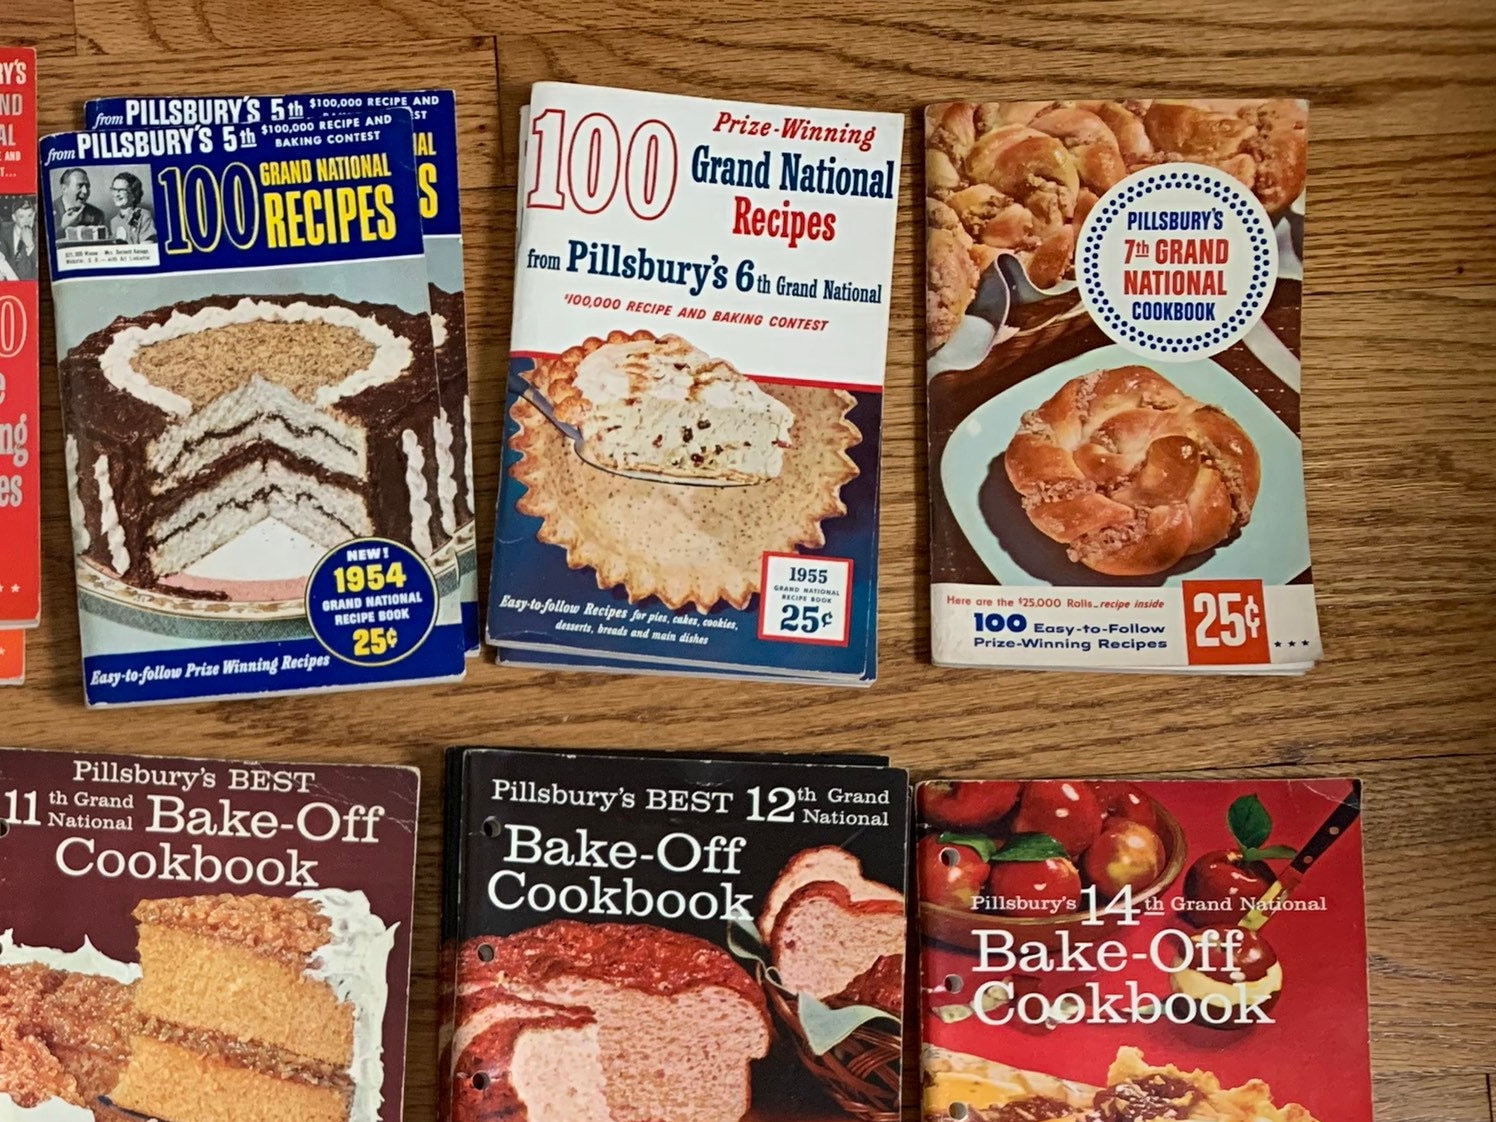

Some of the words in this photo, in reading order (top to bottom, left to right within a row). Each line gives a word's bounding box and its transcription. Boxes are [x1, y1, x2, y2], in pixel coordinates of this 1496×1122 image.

[45, 148, 76, 165] from
[77, 123, 213, 159] PILLSBURY'S
[223, 128, 257, 153] 5th
[713, 111, 876, 152] Prize-Winning
[260, 159, 312, 185] GRAND
[317, 154, 391, 182] NATIONAL
[527, 108, 678, 221] 100
[691, 144, 770, 189] Grand
[779, 152, 894, 199] National
[158, 162, 260, 254] 100
[264, 184, 395, 248] RECIPES
[733, 196, 836, 248] Recipes
[1127, 207, 1223, 230] PILLSBURY'S
[1124, 239, 1149, 264] 7th
[1155, 239, 1229, 264] GRAND
[1124, 270, 1227, 295] NATIONAL
[1132, 302, 1216, 321] COOKBOOK
[334, 562, 406, 593] 1954
[789, 567, 828, 584] 1955
[780, 604, 833, 633] 25¢
[974, 612, 1027, 633] 100
[1034, 623, 1165, 636] Easy-to-Follow
[1194, 592, 1260, 647] 25¢
[353, 627, 398, 656] 25¢
[974, 637, 1091, 652] Prize-Winning
[1098, 638, 1167, 650] Recipes
[73, 760, 216, 791] Pillsbury's
[228, 769, 315, 793] BEST
[146, 795, 384, 843] Bake-Off
[491, 779, 636, 812] Pillsbury's
[645, 789, 734, 813] BEST
[746, 786, 817, 823] 12th
[828, 788, 890, 804] Grand
[803, 809, 889, 826] National
[56, 837, 319, 888] Cookbook
[503, 824, 747, 874] Bake-Off
[487, 870, 754, 922] Cookbook
[971, 896, 1076, 914] Pillsbury's
[1081, 884, 1165, 926] 14th
[1170, 897, 1233, 912] Grand
[1239, 898, 1327, 911] National
[971, 929, 1244, 972] Bake-Off
[972, 980, 1276, 1025] Cookbook
